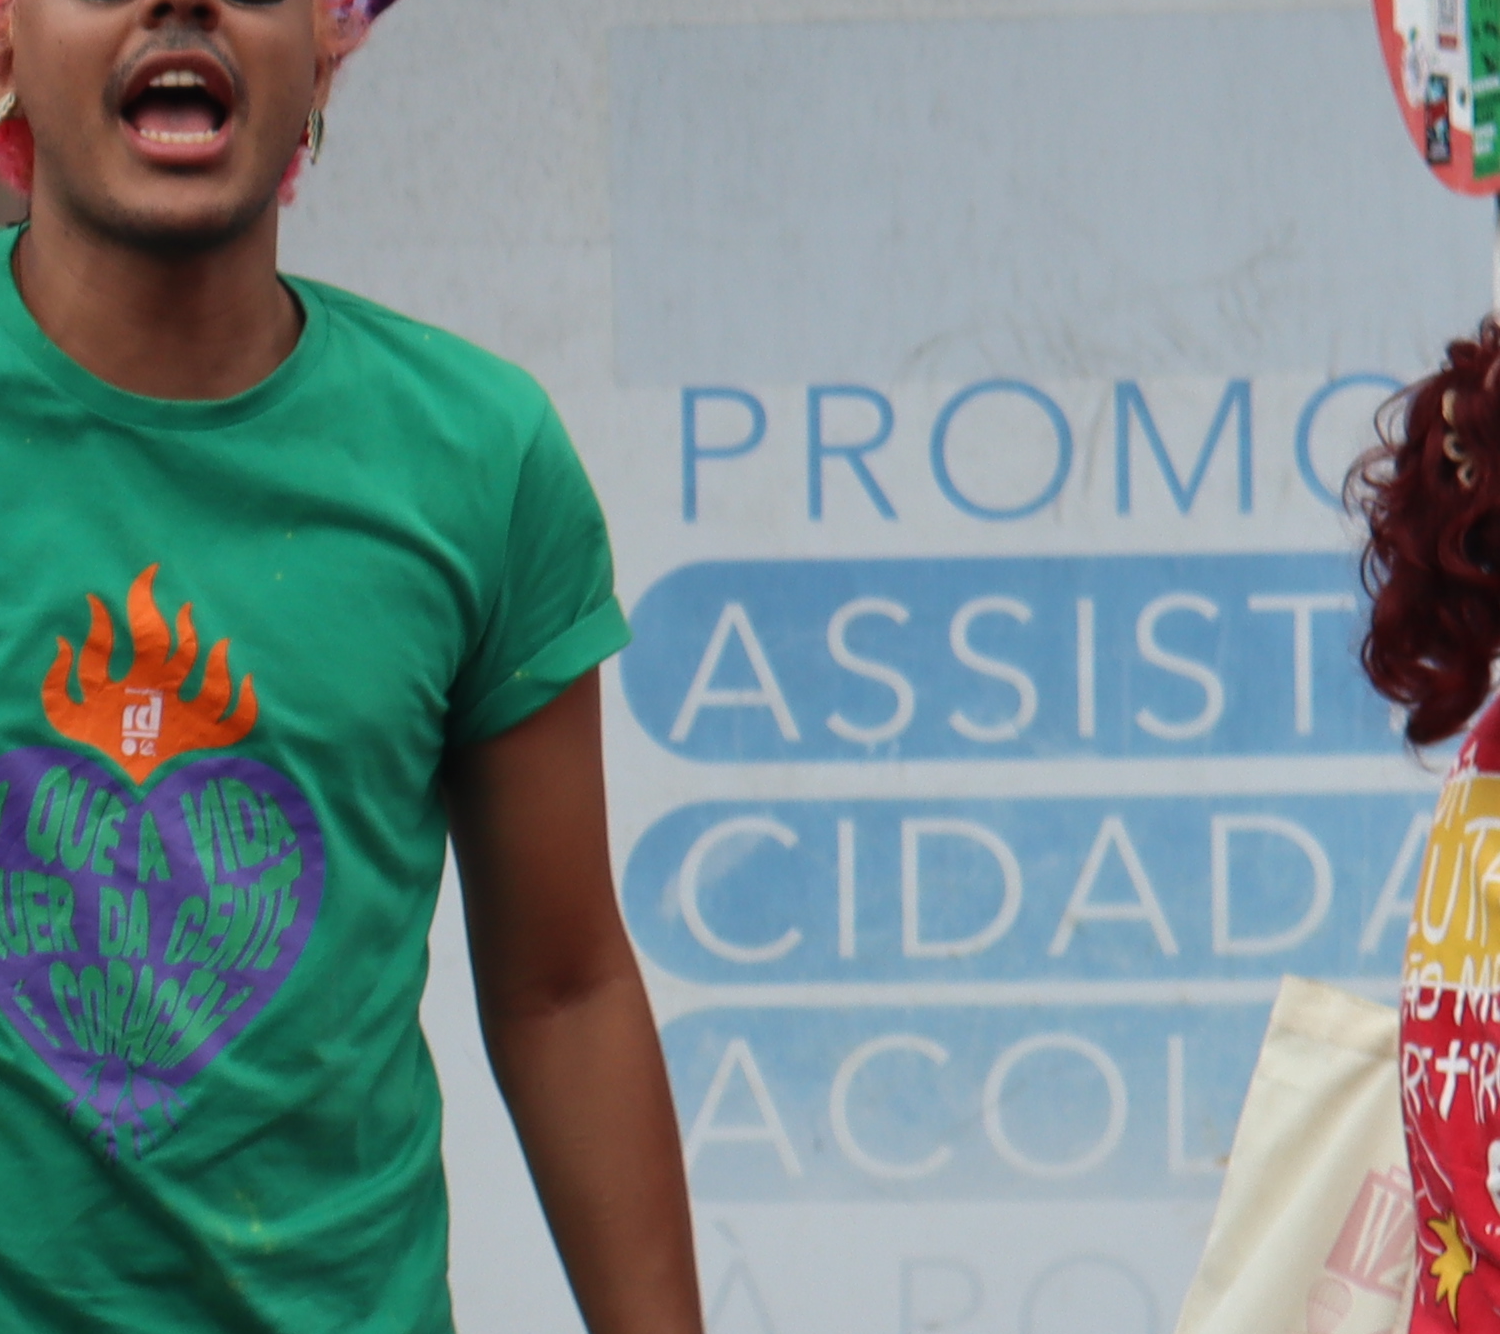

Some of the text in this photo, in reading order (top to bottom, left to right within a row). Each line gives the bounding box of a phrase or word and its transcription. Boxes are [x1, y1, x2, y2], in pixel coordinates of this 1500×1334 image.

[669, 592, 1404, 746] ASSIST
[25, 765, 127, 876] QUE
[137, 810, 171, 883] A
[179, 777, 297, 884] VIDA
[99, 885, 150, 958] DA
[163, 848, 303, 971] GENTE
